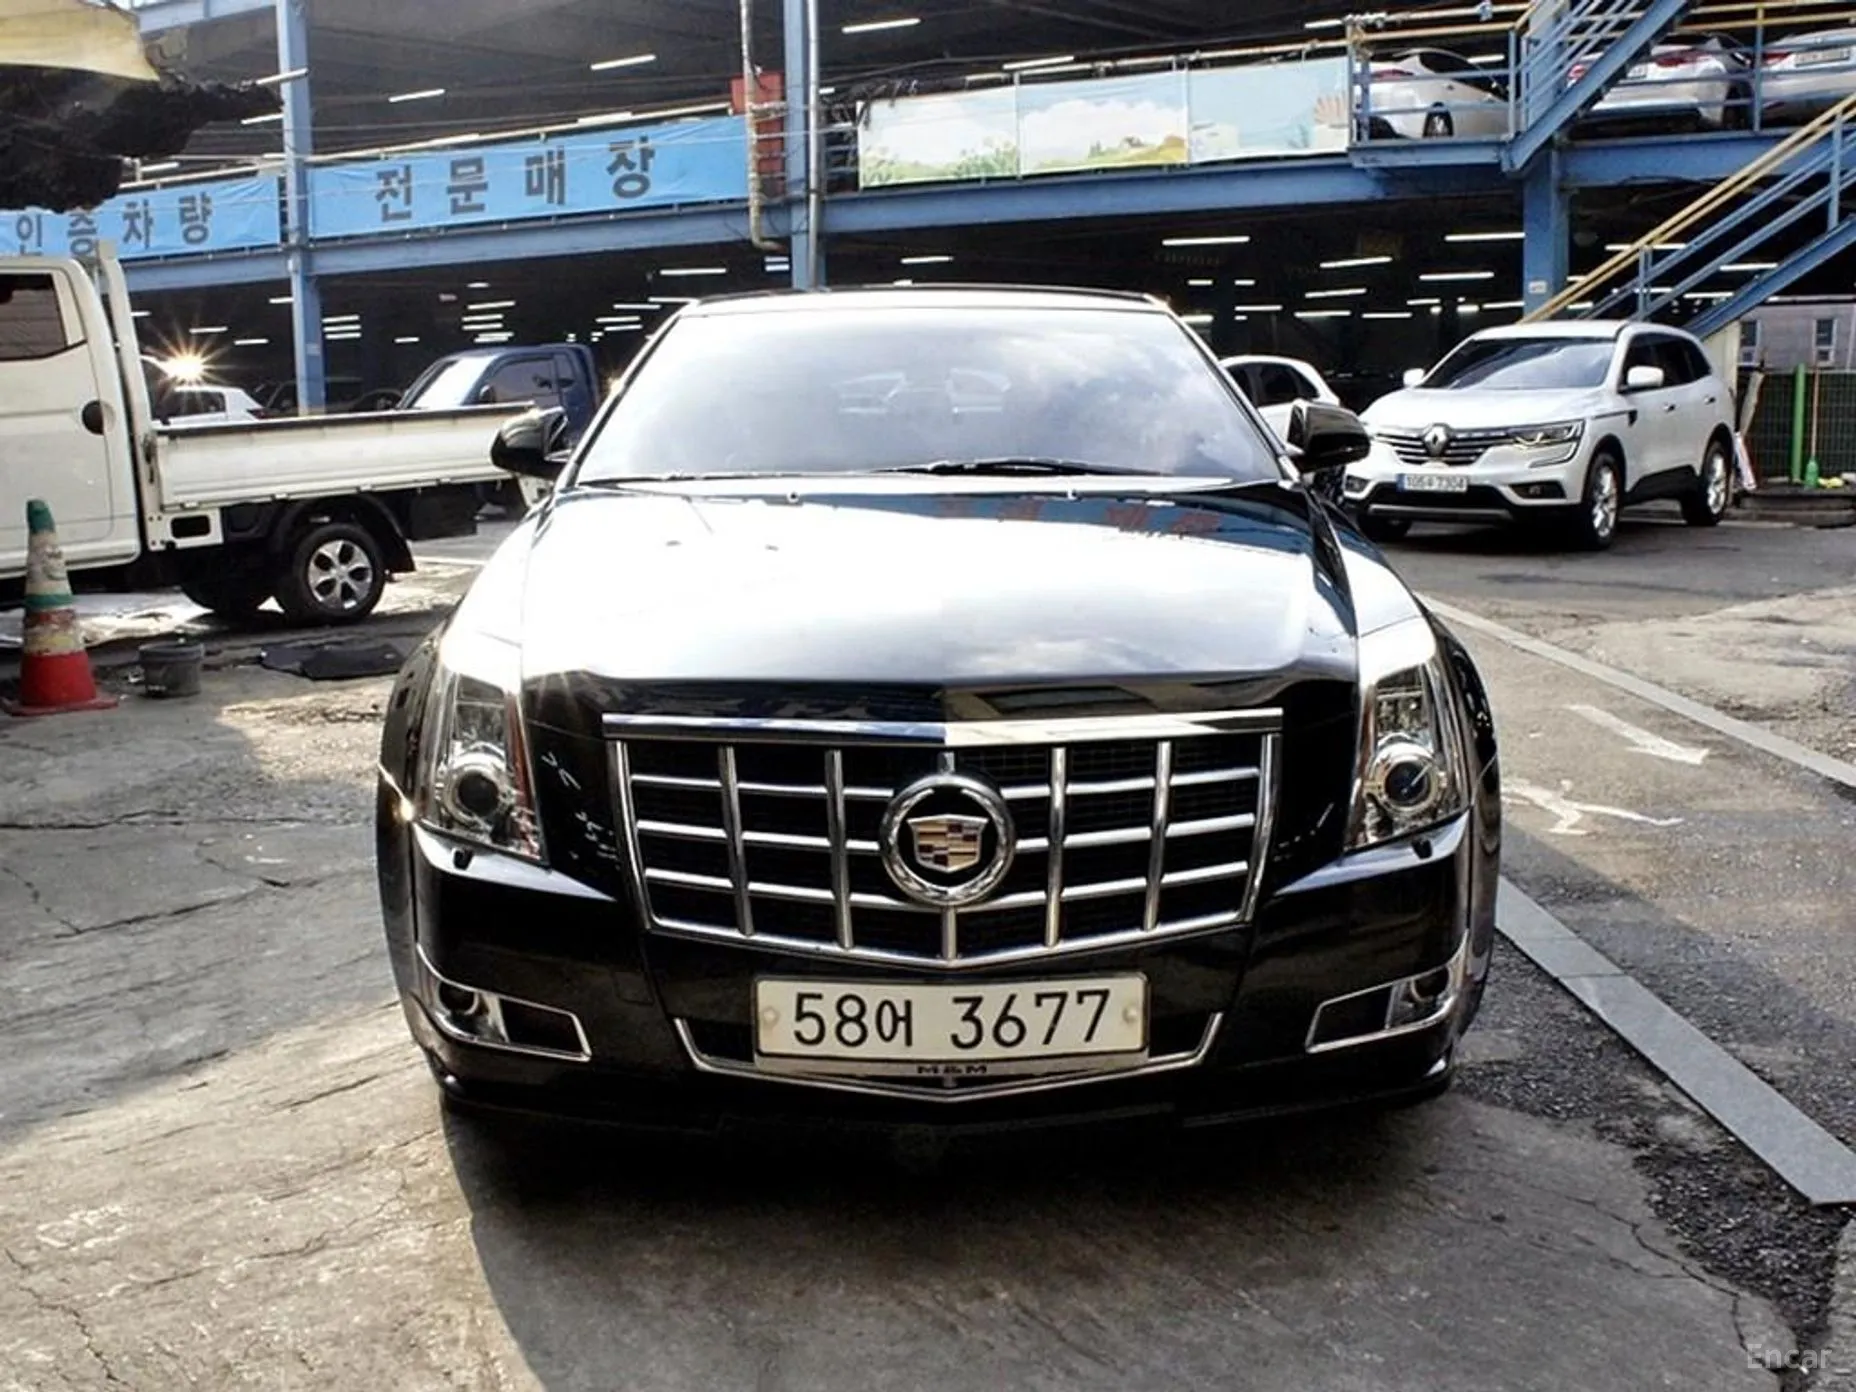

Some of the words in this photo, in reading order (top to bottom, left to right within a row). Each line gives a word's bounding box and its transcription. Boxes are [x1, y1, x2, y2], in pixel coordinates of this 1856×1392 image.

[375, 135, 655, 222] 전문매장
[793, 992, 913, 1048] 58어
[950, 989, 1111, 1050] 3677
